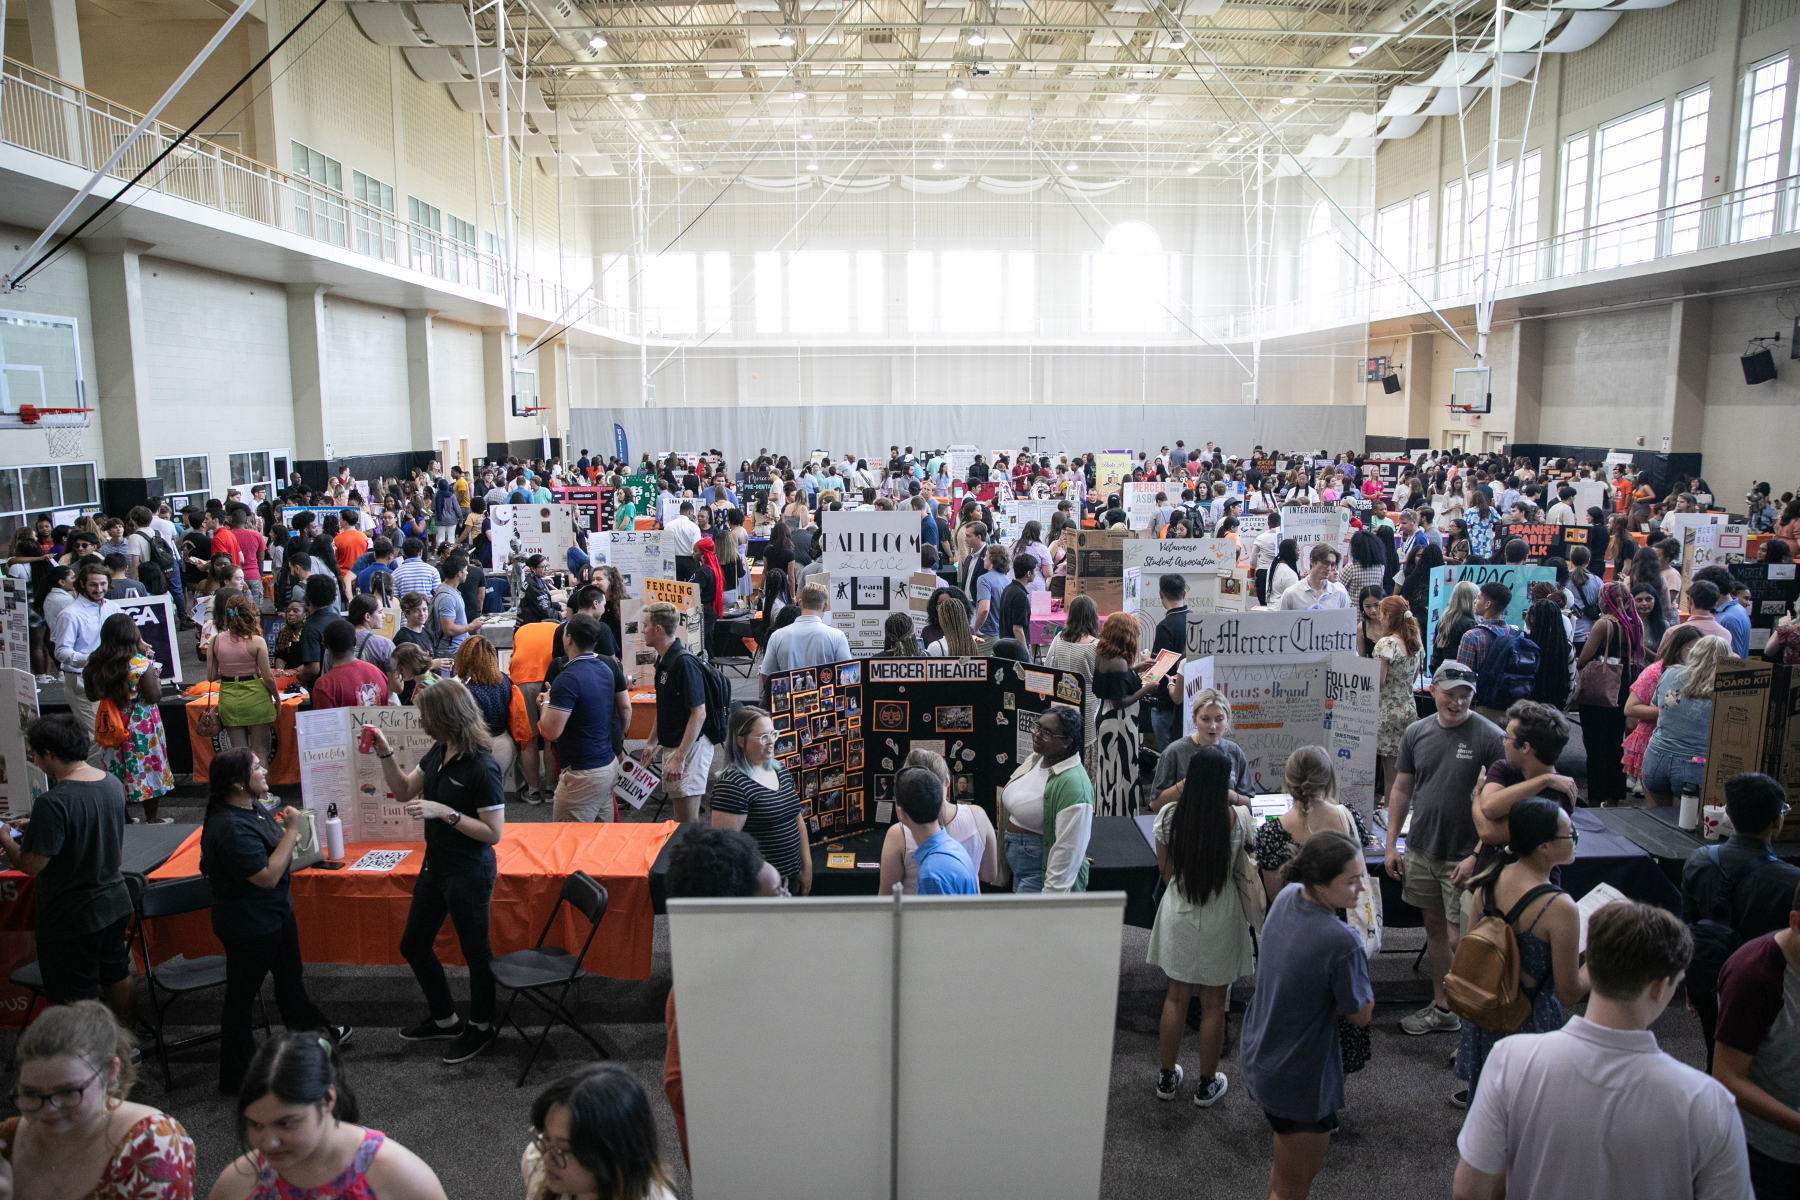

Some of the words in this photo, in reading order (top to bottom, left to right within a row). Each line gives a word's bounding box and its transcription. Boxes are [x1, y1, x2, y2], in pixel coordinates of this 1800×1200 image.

[1133, 483, 1166, 493] MERCER
[1289, 506, 1337, 514] INTERNATIONAL
[1509, 524, 1560, 535] SPANISH
[1724, 526, 1740, 534] INFO
[822, 532, 921, 553] BALLROOM
[1314, 534, 1321, 542] IS
[1159, 541, 1197, 553] Vietnamese
[839, 553, 911, 571] Dance
[1143, 556, 1173, 567] Student
[1174, 556, 1215, 568] Association
[1737, 567, 1764, 579] MERCER
[646, 580, 693, 596] FENCING
[657, 593, 683, 604] CLUB
[1140, 598, 1161, 608] MERCE
[120, 606, 160, 627] GA
[1186, 619, 1215, 654] The
[1216, 618, 1288, 655] Mercer
[1289, 616, 1357, 652] Cluster
[870, 663, 925, 679] MERCER
[927, 662, 986, 679] THEATRE
[1221, 665, 1262, 682] Who
[1186, 675, 1202, 699] WIN!
[1326, 671, 1371, 691] FOLLOW
[1715, 678, 1751, 689] BOARD
[1753, 676, 1770, 685] KIT
[1215, 682, 1260, 699] News
[1271, 681, 1309, 698] Brand
[1325, 685, 1343, 702] US!
[351, 712, 373, 730] Nu
[378, 710, 402, 728] Rho
[303, 748, 346, 763] Benefits
[1722, 753, 1742, 761] DESIGN
[631, 766, 658, 790] MAFIA
[383, 805, 401, 816] Fun
